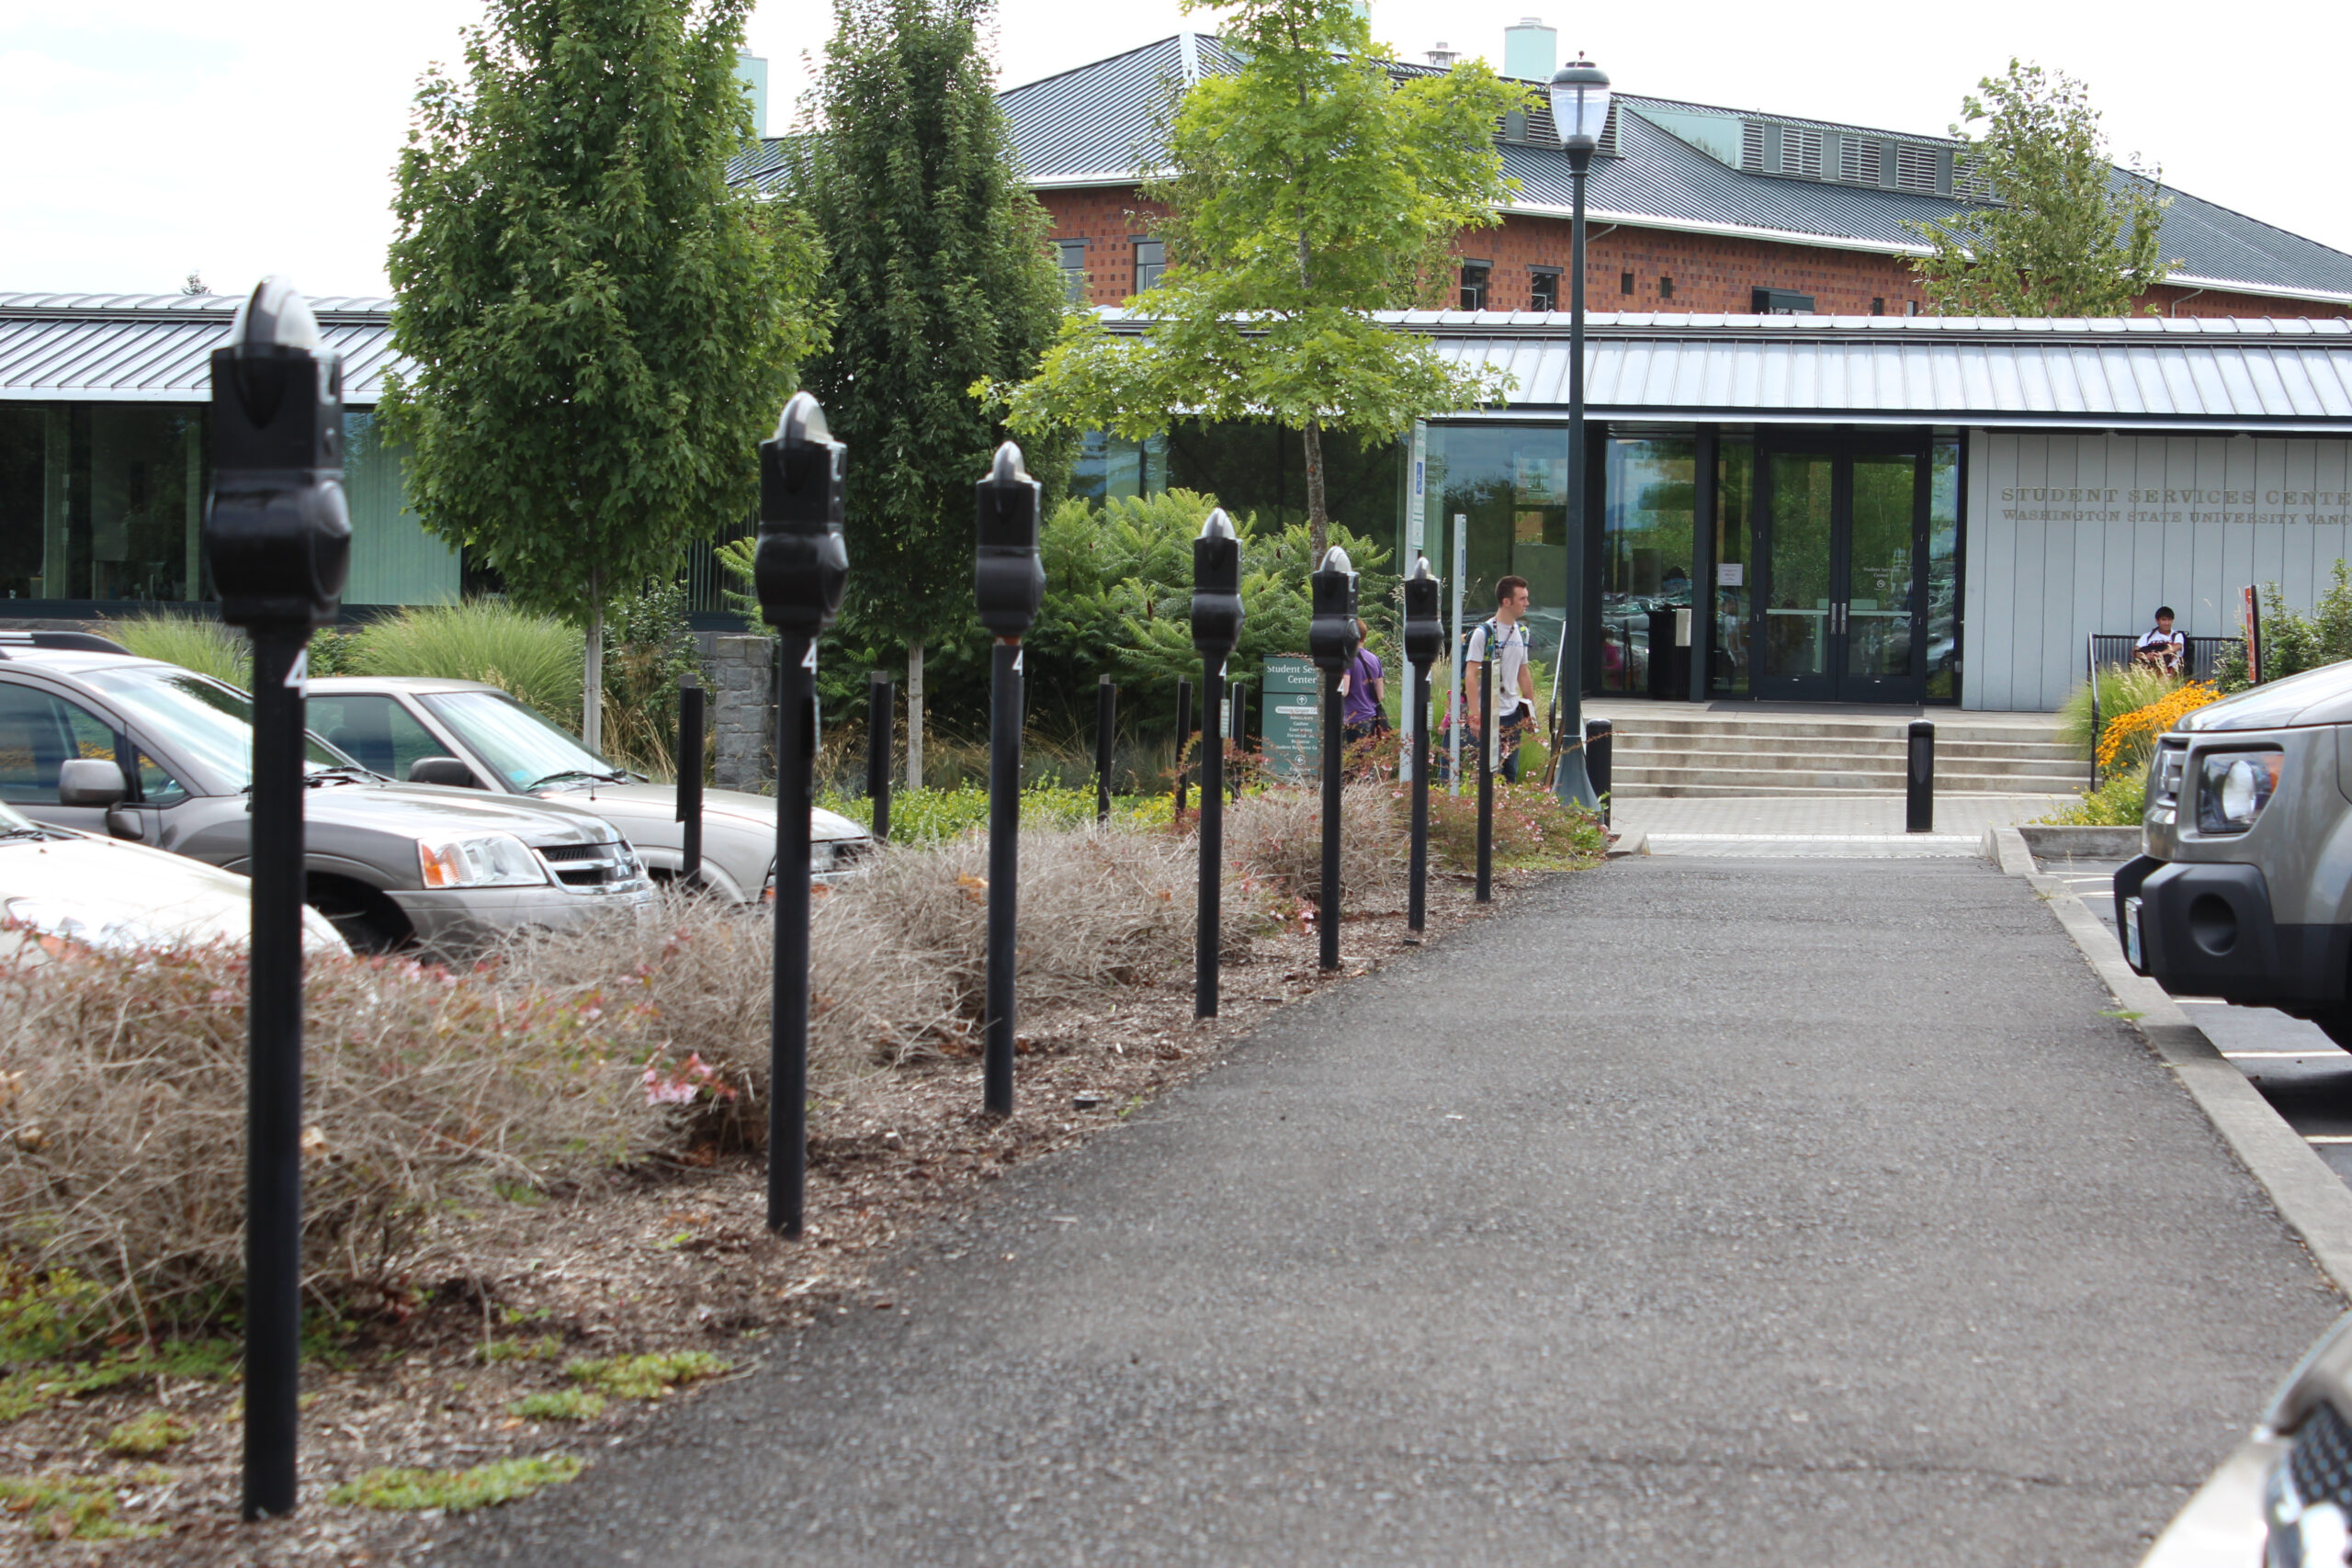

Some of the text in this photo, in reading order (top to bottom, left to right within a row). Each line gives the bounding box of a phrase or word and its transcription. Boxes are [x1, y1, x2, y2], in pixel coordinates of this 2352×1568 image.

[2001, 487, 2119, 502] STUDENT
[2128, 489, 2256, 504] SERVICES
[2001, 509, 2121, 522] WASHINGTON
[2127, 511, 2182, 523] STATE
[2189, 513, 2300, 525] UNIVERSITY
[1267, 664, 1300, 673] Student
[1287, 674, 1317, 684] Center
